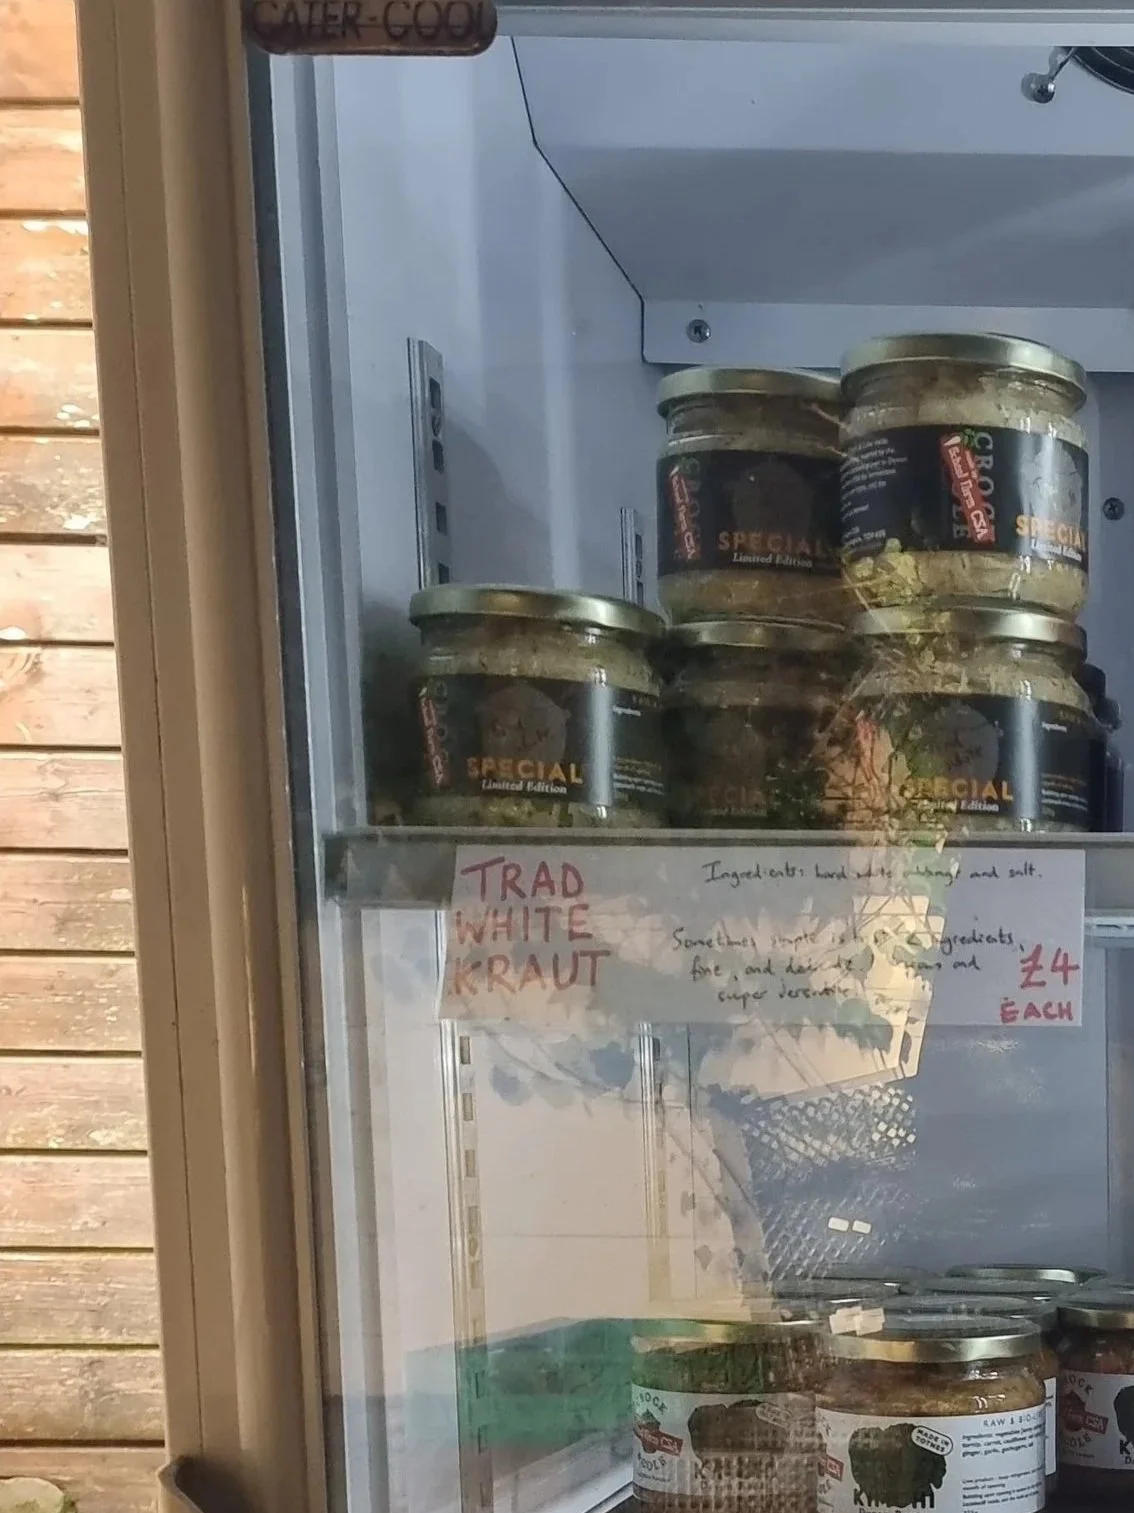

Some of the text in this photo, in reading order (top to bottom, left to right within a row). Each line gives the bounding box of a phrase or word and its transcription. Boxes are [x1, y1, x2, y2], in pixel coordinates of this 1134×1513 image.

[970, 510, 989, 540] CSA
[465, 756, 584, 786] SPECIAL
[481, 779, 568, 795] Limited Edition
[461, 856, 584, 902] TRAD
[455, 902, 593, 945] WHITE
[447, 949, 611, 996] KRAUT
[1019, 944, 1079, 989] £4
[1000, 998, 1074, 1024] EACH
